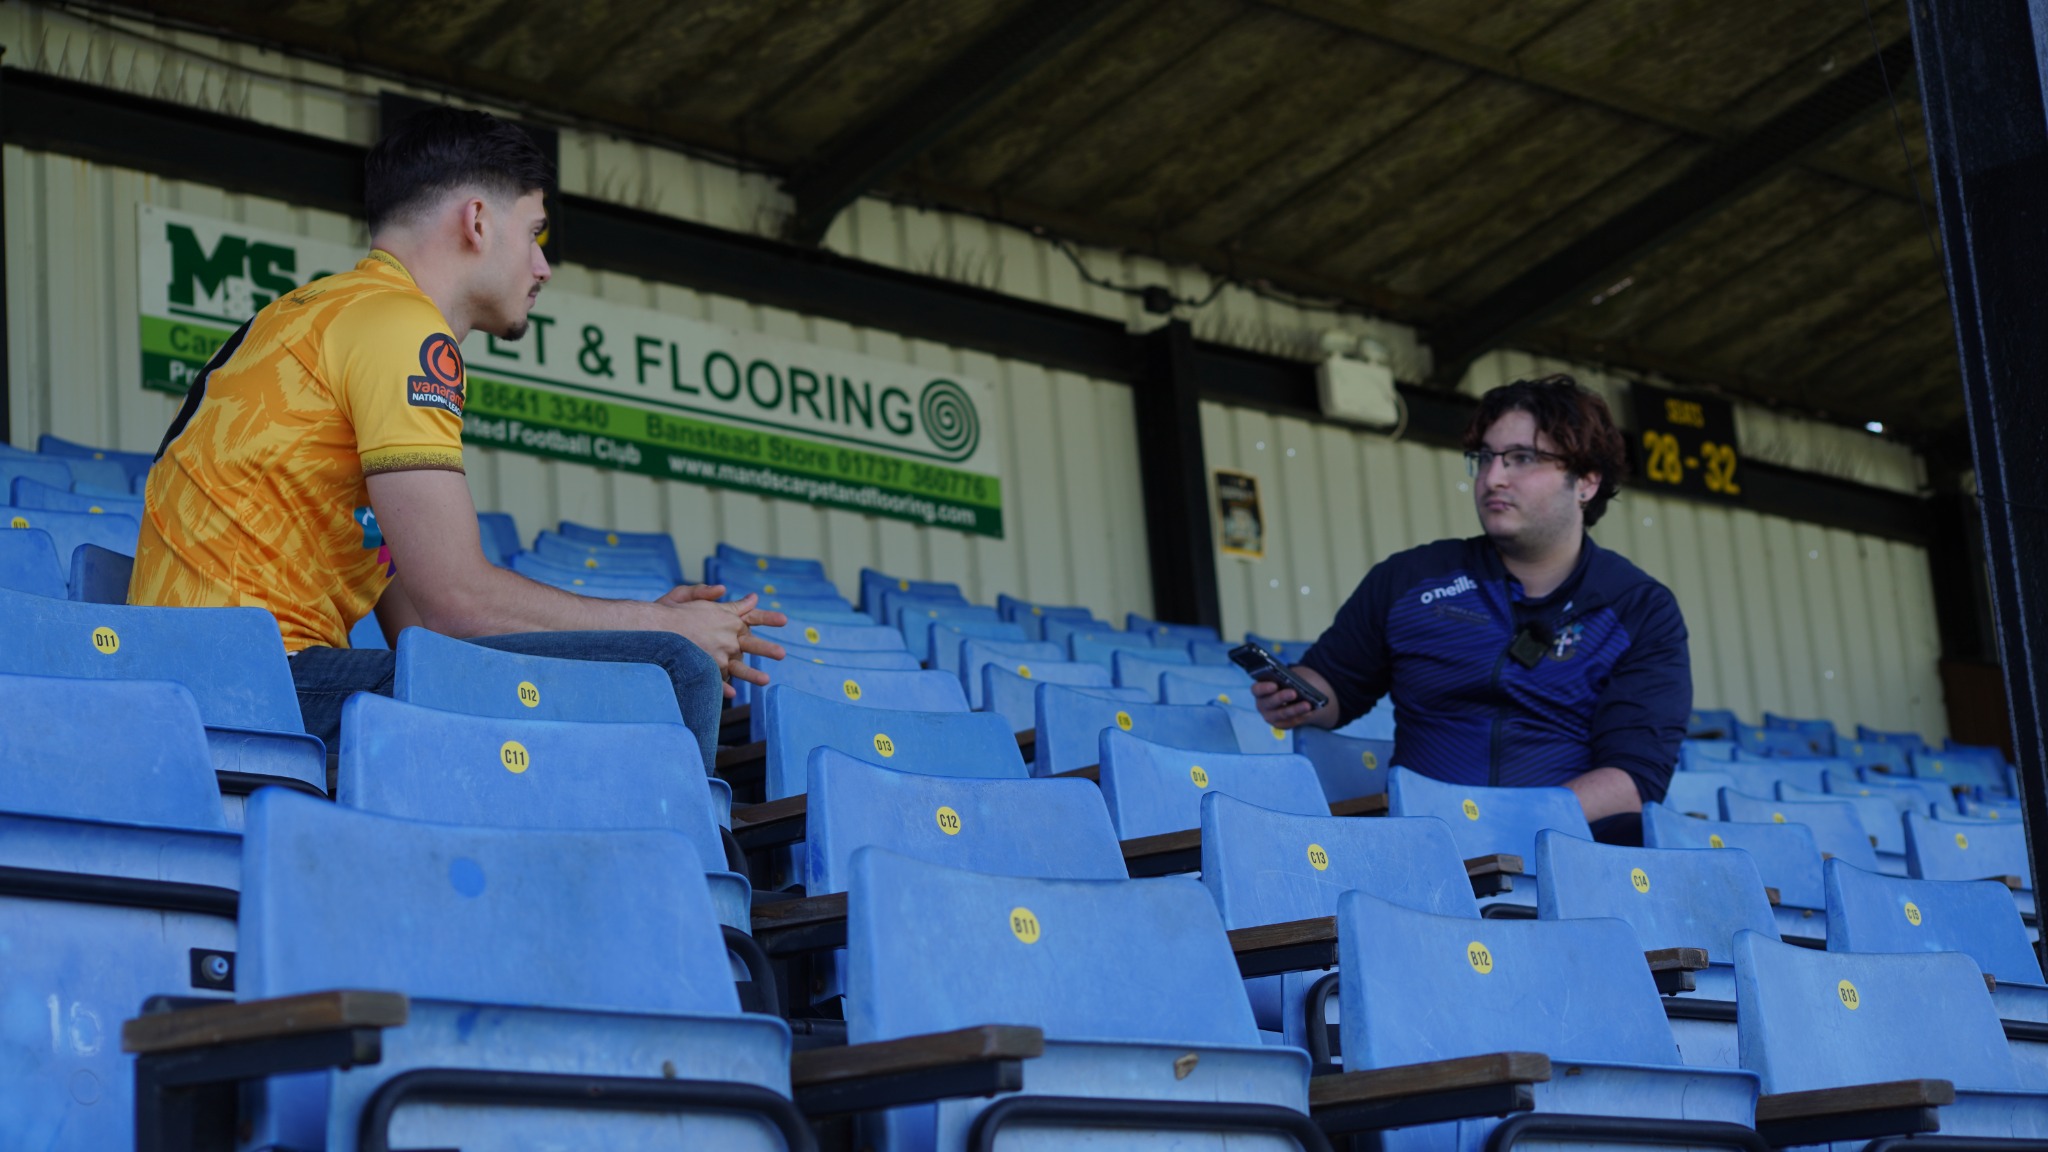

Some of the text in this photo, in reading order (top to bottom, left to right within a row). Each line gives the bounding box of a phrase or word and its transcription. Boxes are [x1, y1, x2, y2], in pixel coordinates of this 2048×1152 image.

[577, 323, 616, 379] &
[635, 333, 915, 437] FLOORING
[508, 420, 593, 457] Football
[593, 436, 642, 466] Club
[646, 413, 760, 456] Banstead
[768, 435, 831, 471] Store
[96, 633, 116, 648] D11
[520, 687, 537, 702] D12
[876, 739, 892, 752] D13
[504, 749, 525, 766] C11
[1192, 771, 1207, 783] D14
[939, 813, 959, 829] C12
[1310, 851, 1327, 865] C13
[1633, 875, 1648, 887] C14
[1906, 908, 1920, 921] C15
[1013, 916, 1036, 935] B11
[1470, 950, 1490, 966] B12
[1839, 987, 1857, 1003] B13
